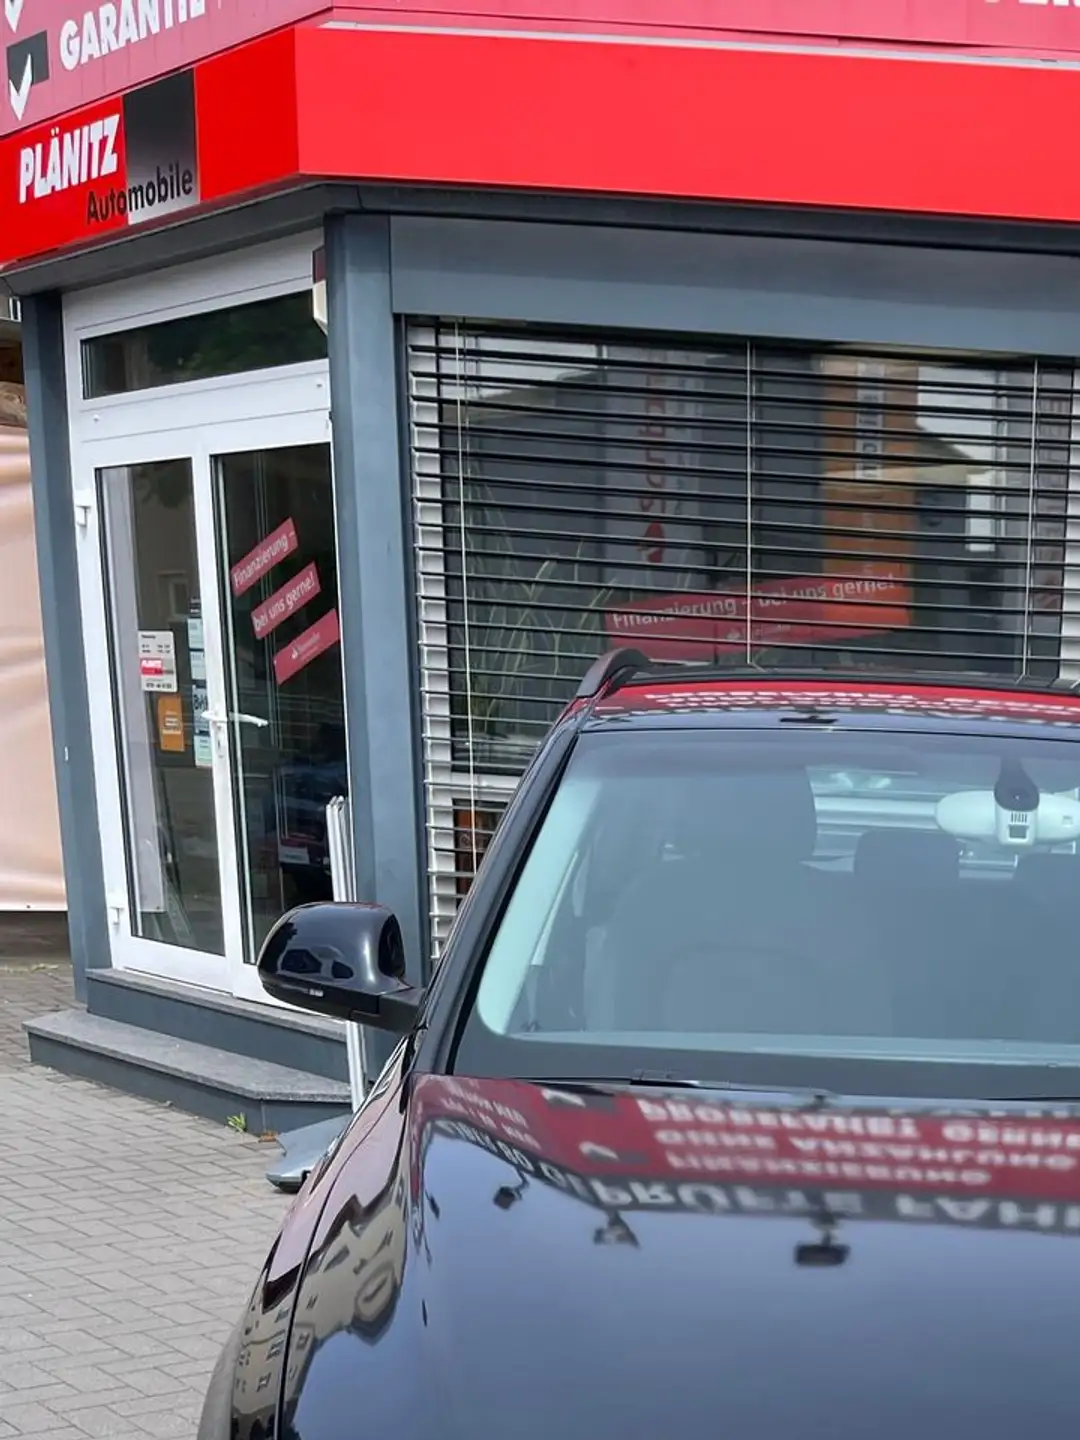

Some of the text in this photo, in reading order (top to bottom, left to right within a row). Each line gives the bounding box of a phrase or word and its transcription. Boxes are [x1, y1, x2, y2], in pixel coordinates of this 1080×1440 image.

[19, 114, 120, 203] PLÄNITZ
[87, 160, 193, 225] Automobile
[233, 534, 288, 588] Finanzierung
[253, 571, 314, 632] bei uns gerne!
